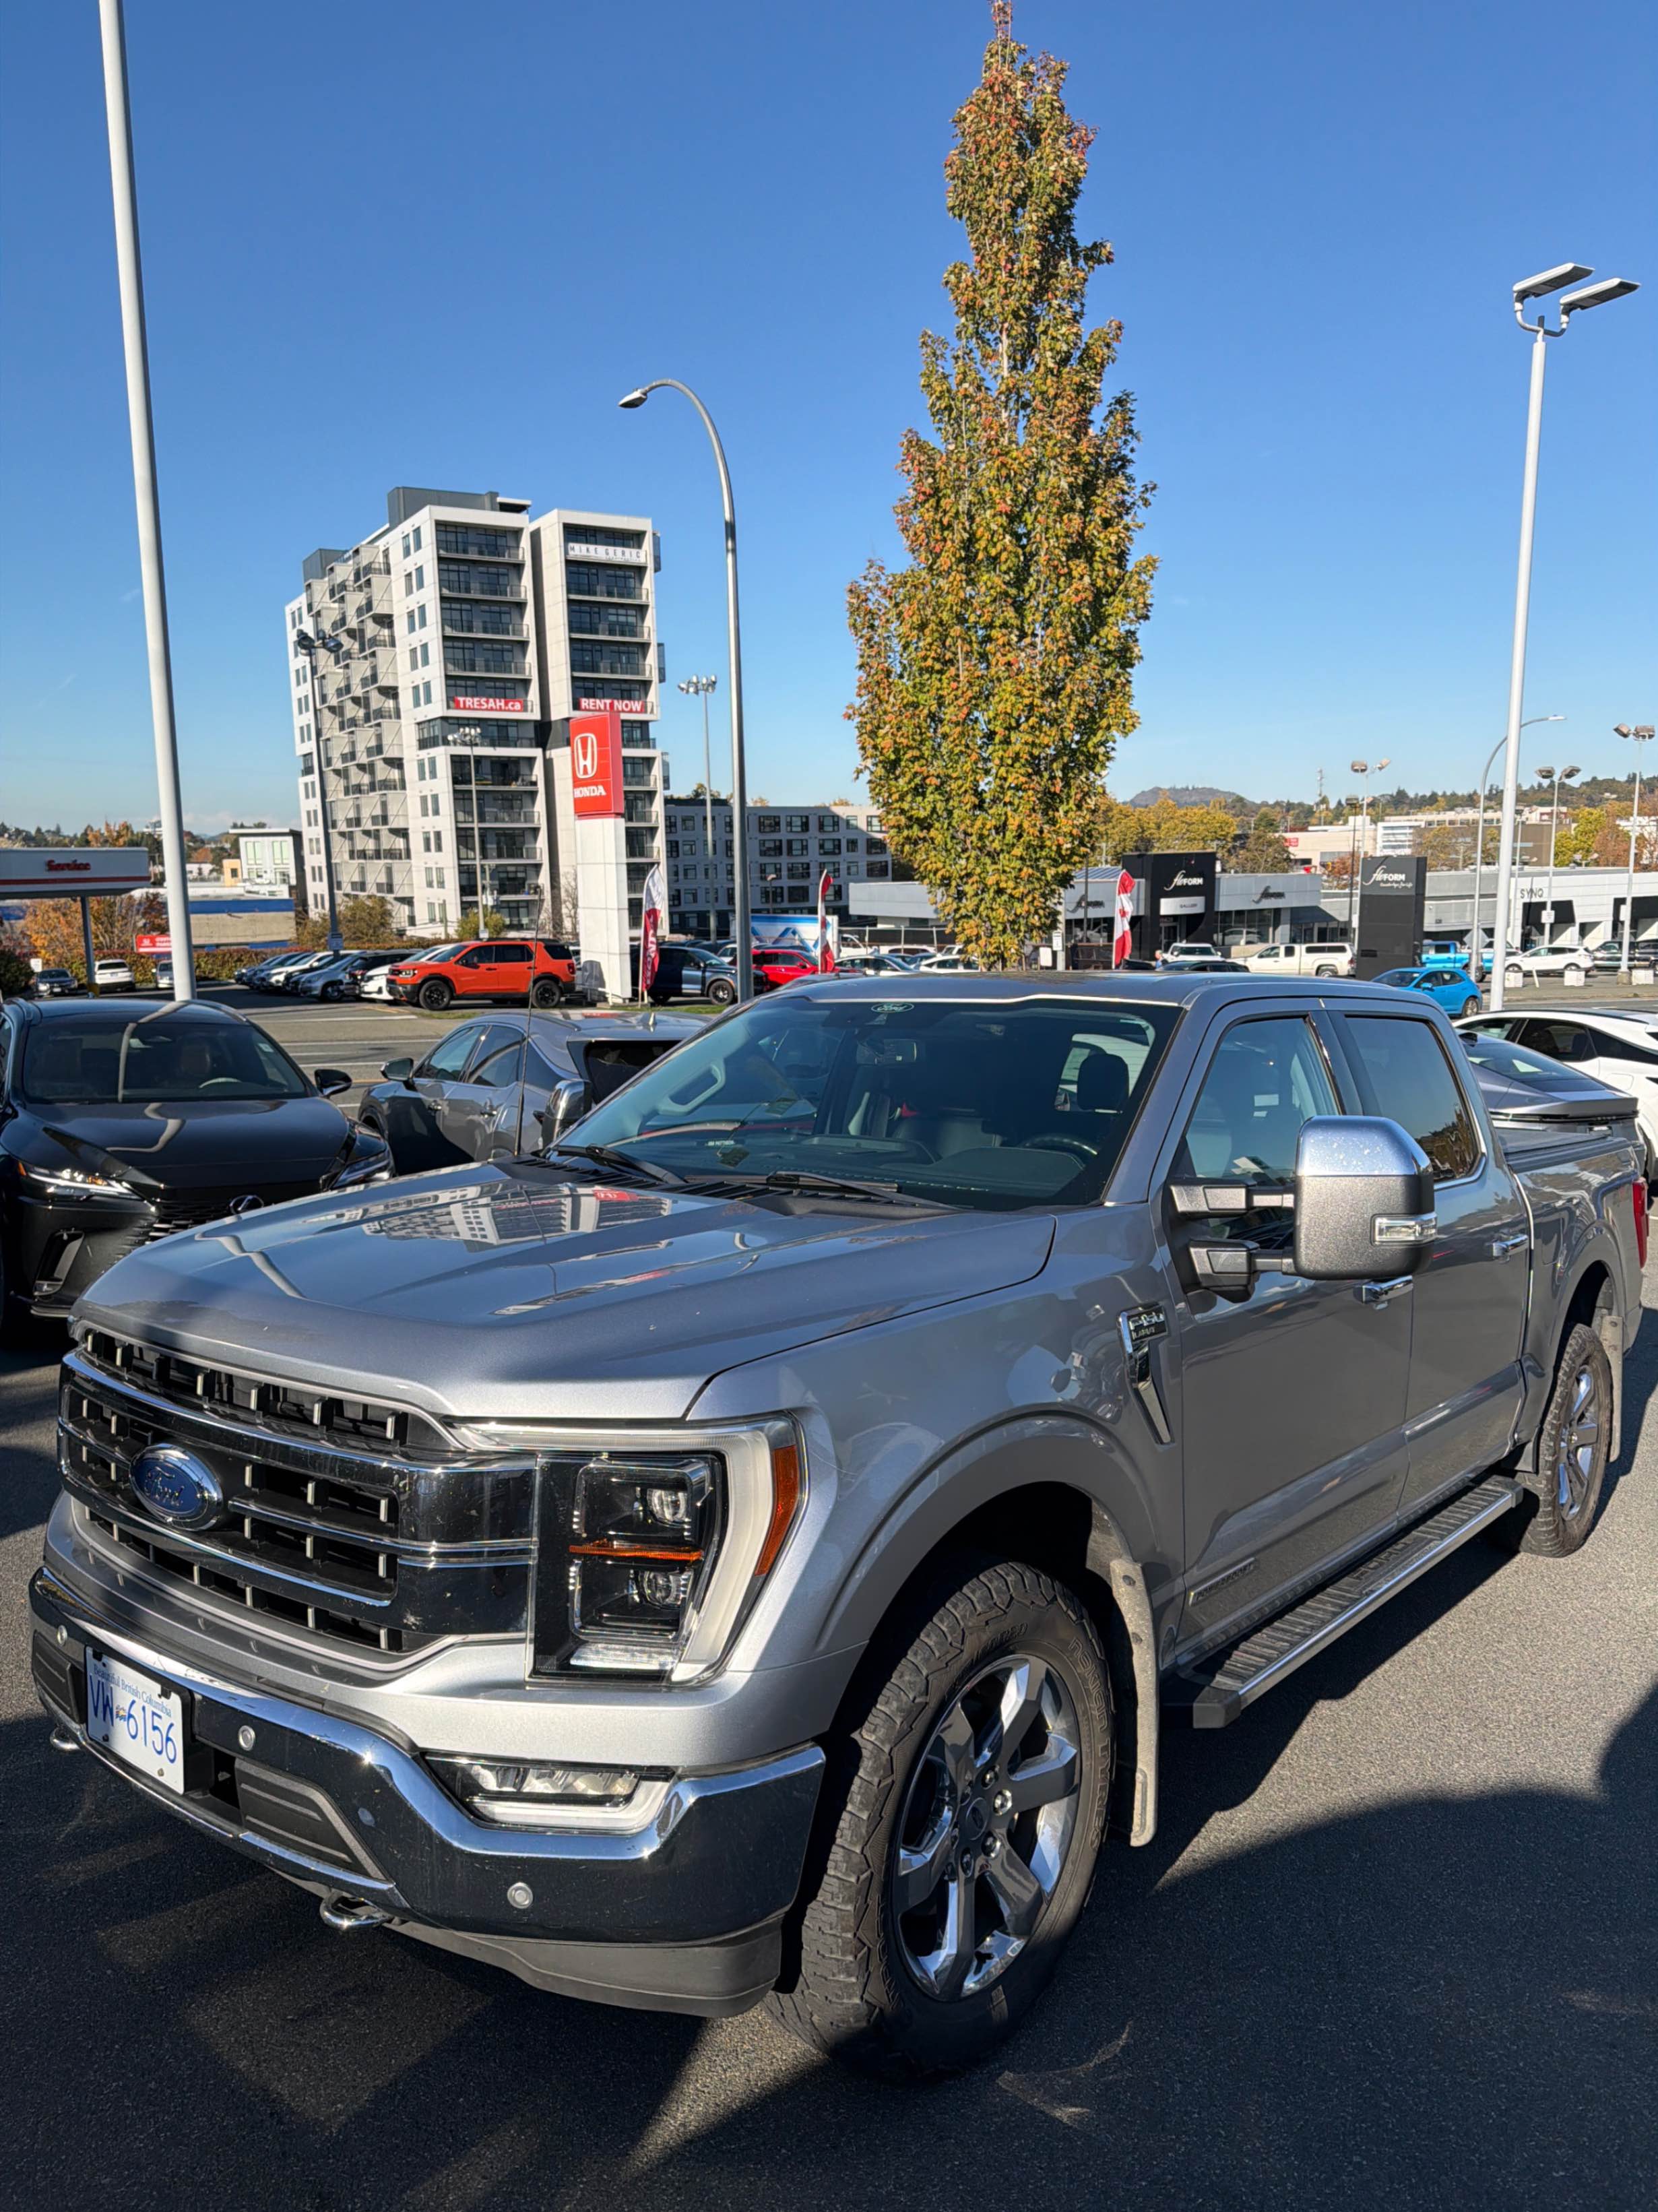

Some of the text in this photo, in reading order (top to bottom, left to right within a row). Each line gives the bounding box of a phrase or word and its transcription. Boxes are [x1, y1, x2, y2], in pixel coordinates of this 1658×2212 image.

[569, 544, 641, 559] MIKE GERIC
[457, 697, 521, 711] TRESAH.ca
[581, 697, 643, 712] RENT NOW
[573, 785, 606, 798] HONDA
[144, 1466, 185, 1507] Ford
[94, 1664, 171, 1717] Beautiful British Columbia
[89, 1674, 177, 1764] VW 6156
